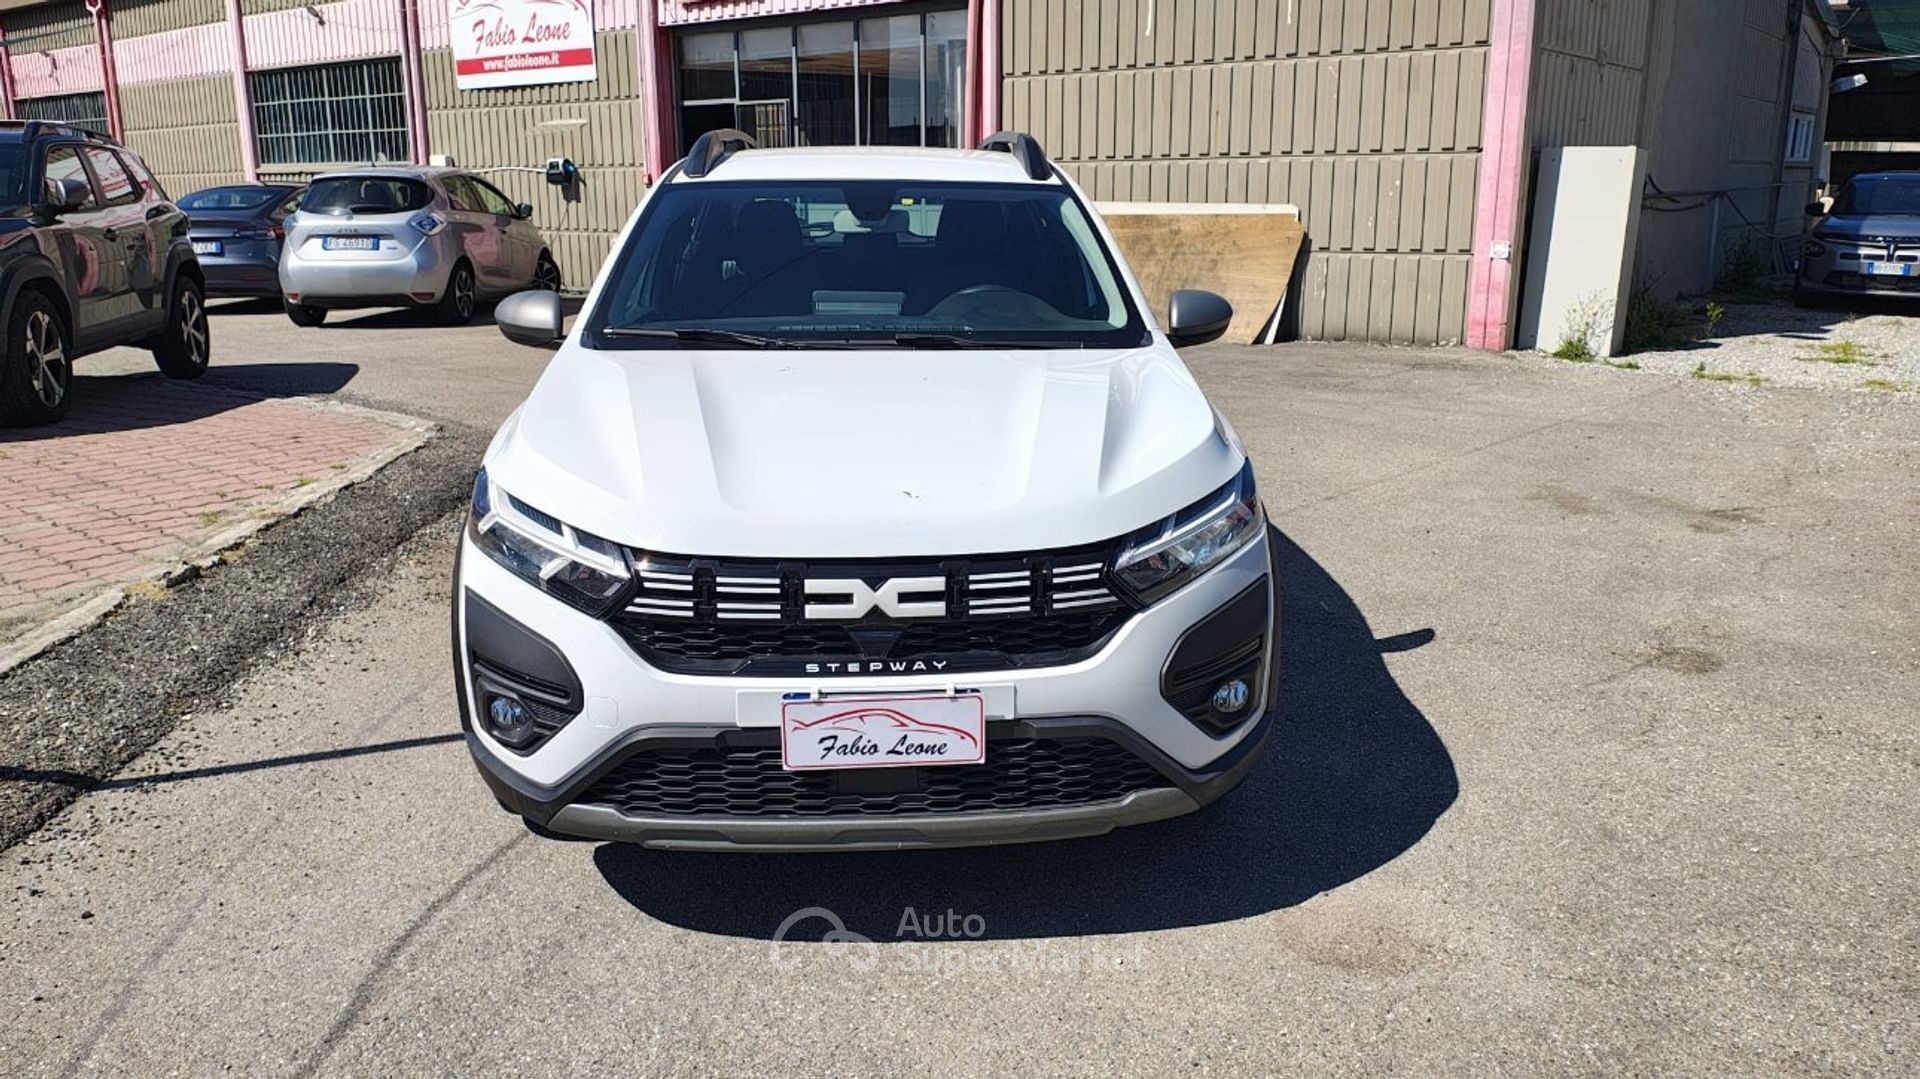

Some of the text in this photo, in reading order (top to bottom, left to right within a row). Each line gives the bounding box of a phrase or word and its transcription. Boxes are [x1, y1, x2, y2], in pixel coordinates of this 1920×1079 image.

[472, 11, 571, 54] Fabio Leone
[483, 52, 559, 71] www.fabioleone.it
[805, 661, 947, 673] STEPWAY
[817, 734, 947, 760] Fabio Leone
